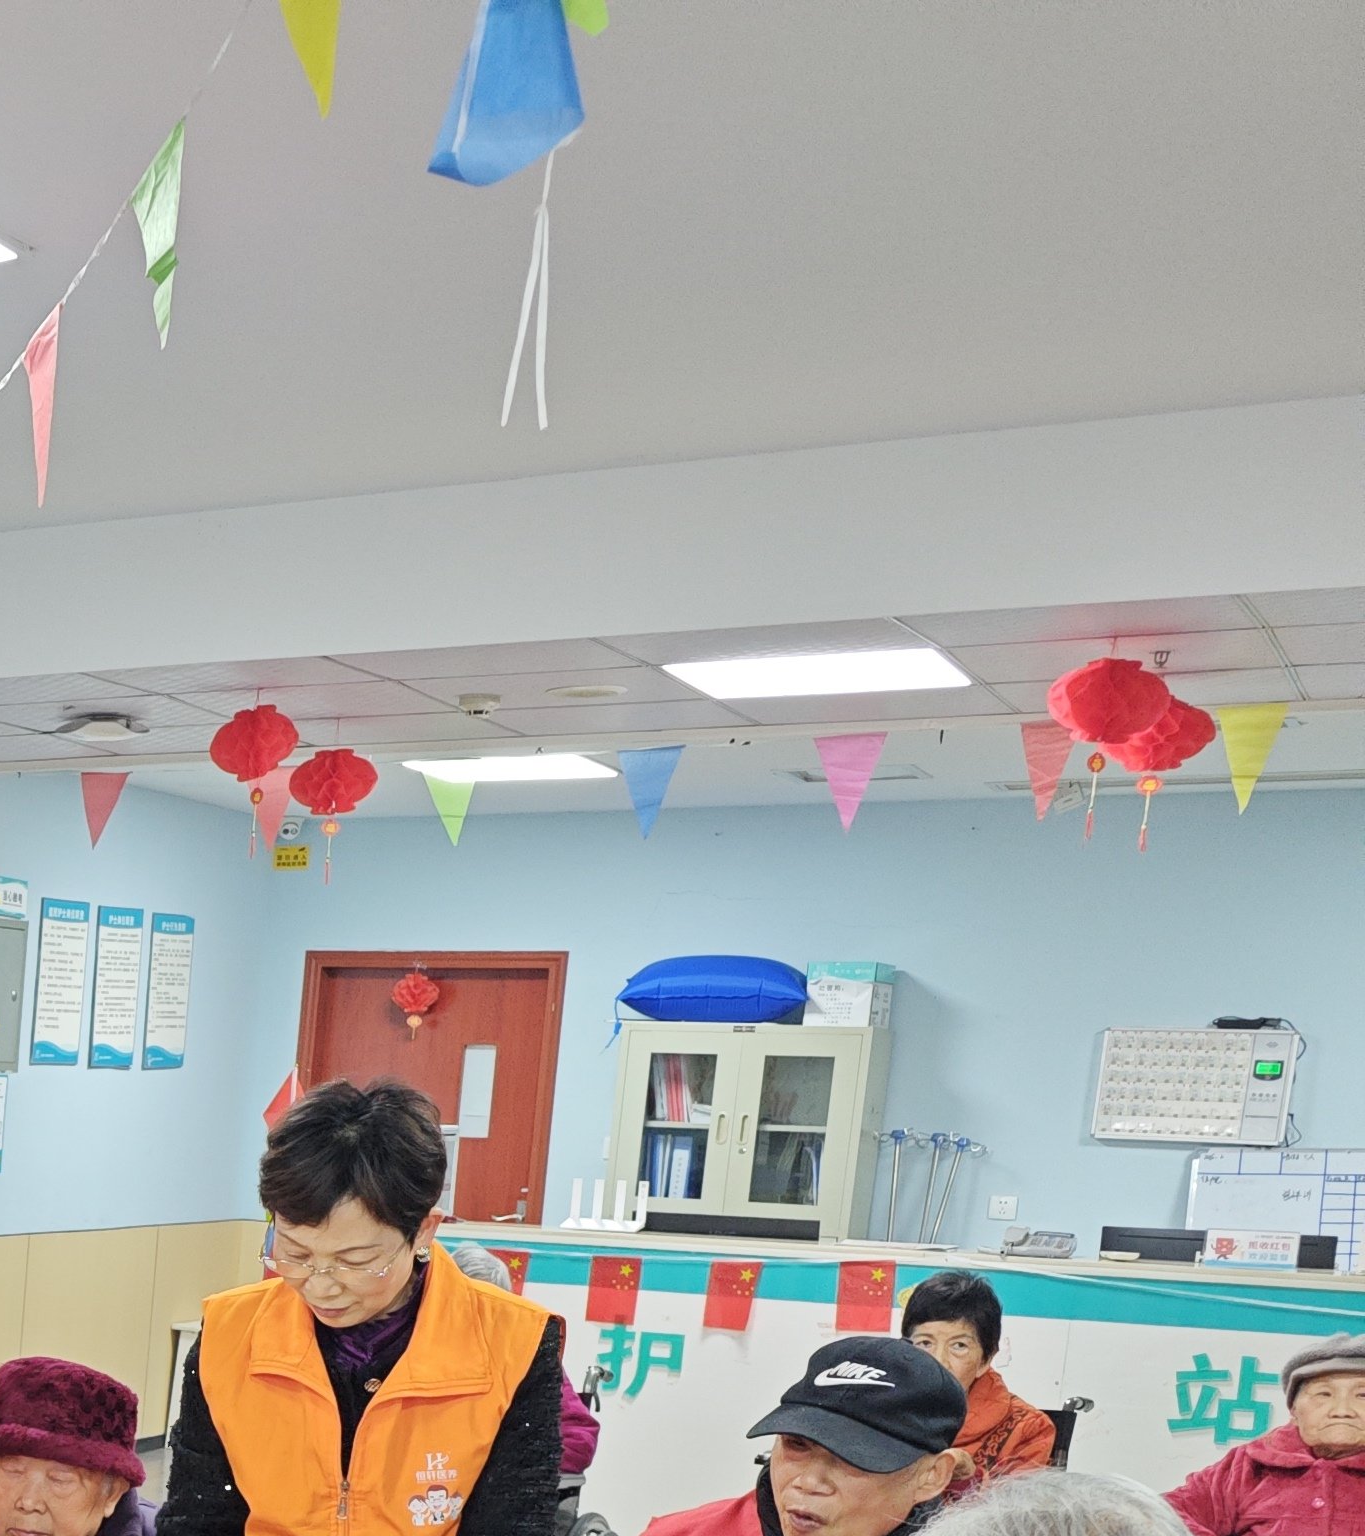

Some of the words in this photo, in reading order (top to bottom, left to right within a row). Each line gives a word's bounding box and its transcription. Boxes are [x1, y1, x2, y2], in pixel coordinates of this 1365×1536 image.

[596, 1323, 686, 1399] 护
[1167, 1352, 1280, 1446] 站
[829, 1361, 887, 1380] NIKE
